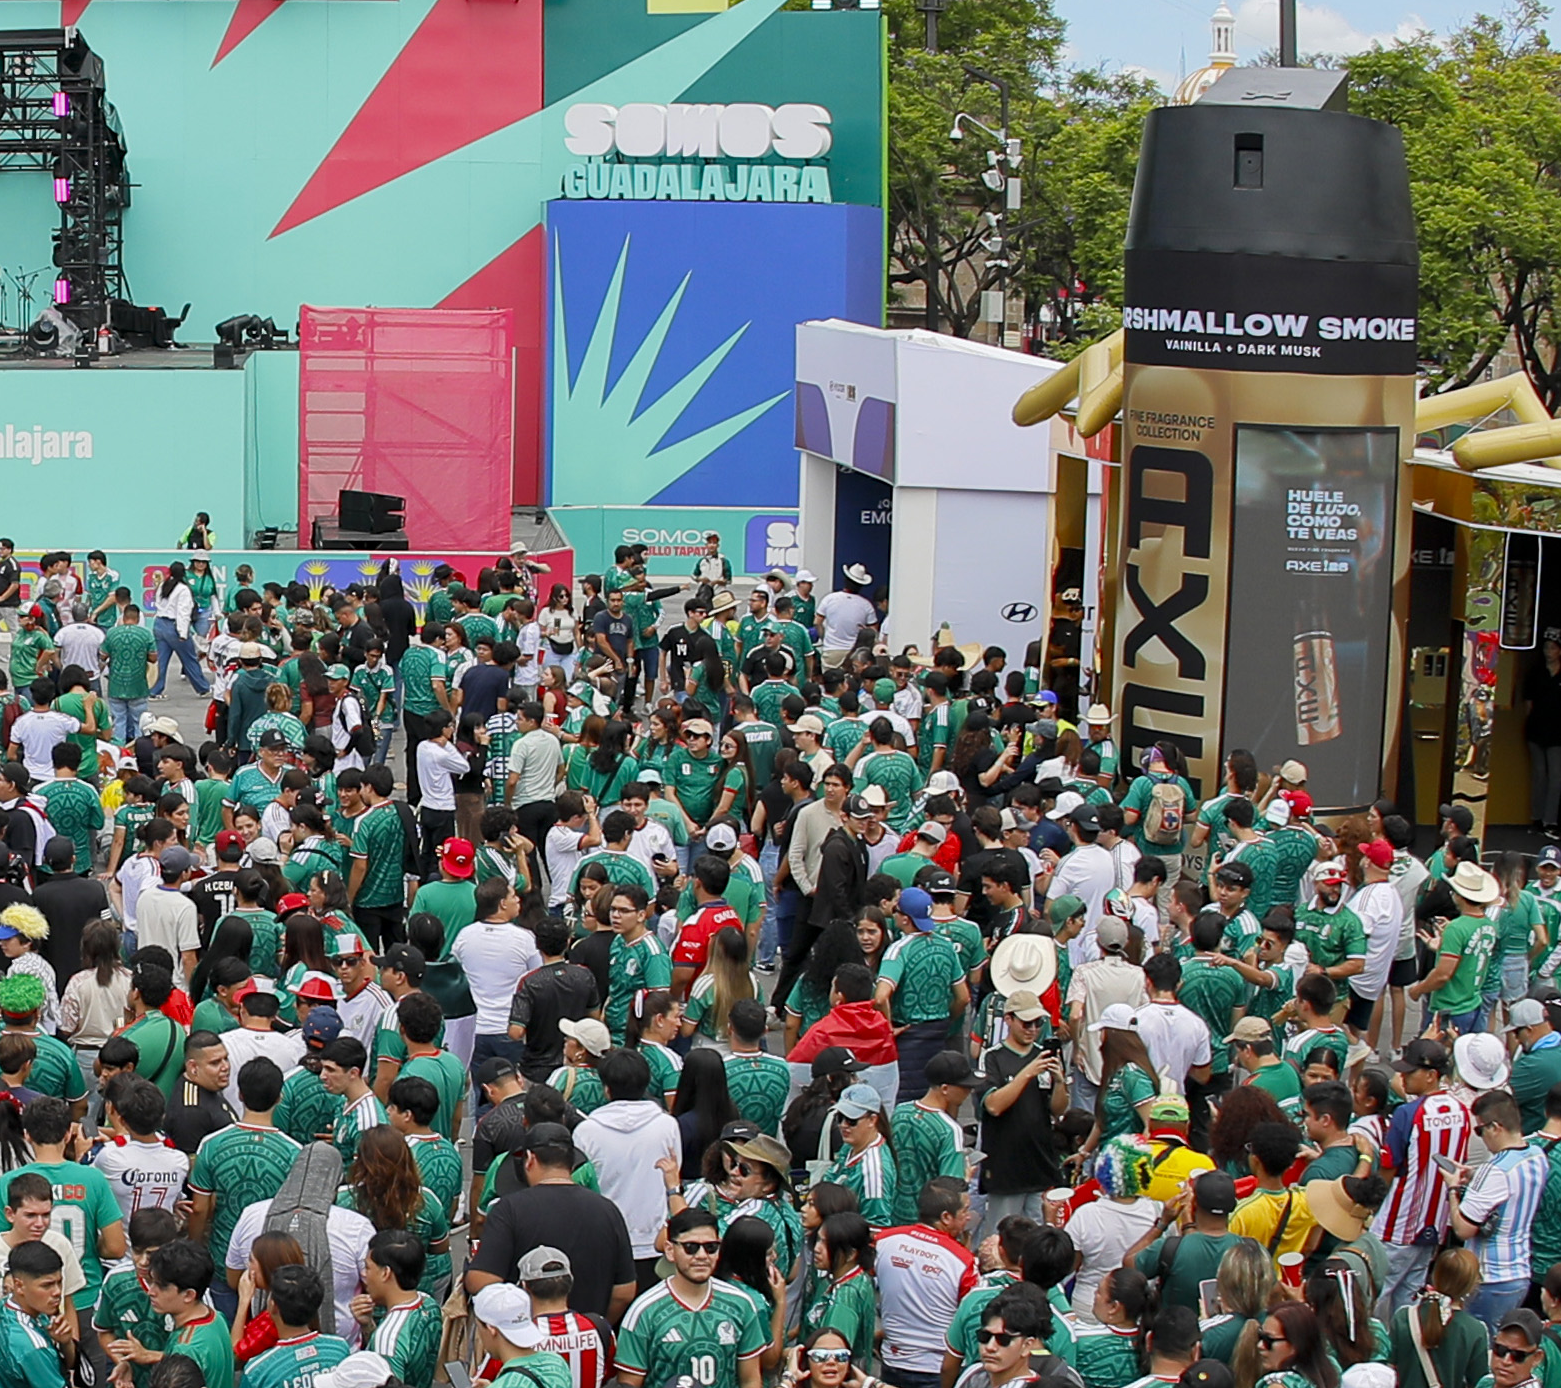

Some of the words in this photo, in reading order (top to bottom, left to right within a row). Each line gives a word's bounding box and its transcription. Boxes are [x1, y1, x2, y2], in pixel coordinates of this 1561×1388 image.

[564, 103, 832, 159] SOMOS
[562, 163, 832, 204] GUADALAJARA
[1123, 306, 1310, 338] RSHMALLOW
[1318, 316, 1415, 342] SMOKE
[1165, 339, 1222, 354] VAINILLA
[1237, 344, 1276, 357] DARK
[1281, 345, 1322, 359] MUSK
[1130, 410, 1146, 424] FINE
[1146, 412, 1216, 430] FRAGRANCE
[1136, 423, 1201, 442] COLLECTION
[1288, 489, 1343, 502] HUELE
[1287, 502, 1311, 514] DE
[1315, 504, 1361, 517] LUJO,
[1287, 515, 1341, 527] COMO
[1286, 527, 1309, 539] TE
[1313, 528, 1357, 541] VEAS
[1286, 560, 1322, 572] AXE
[1121, 444, 1214, 803] AXE
[1426, 1115, 1462, 1128] TOYOTA
[122, 1168, 178, 1186] Corona
[690, 1354, 716, 1386] 10
